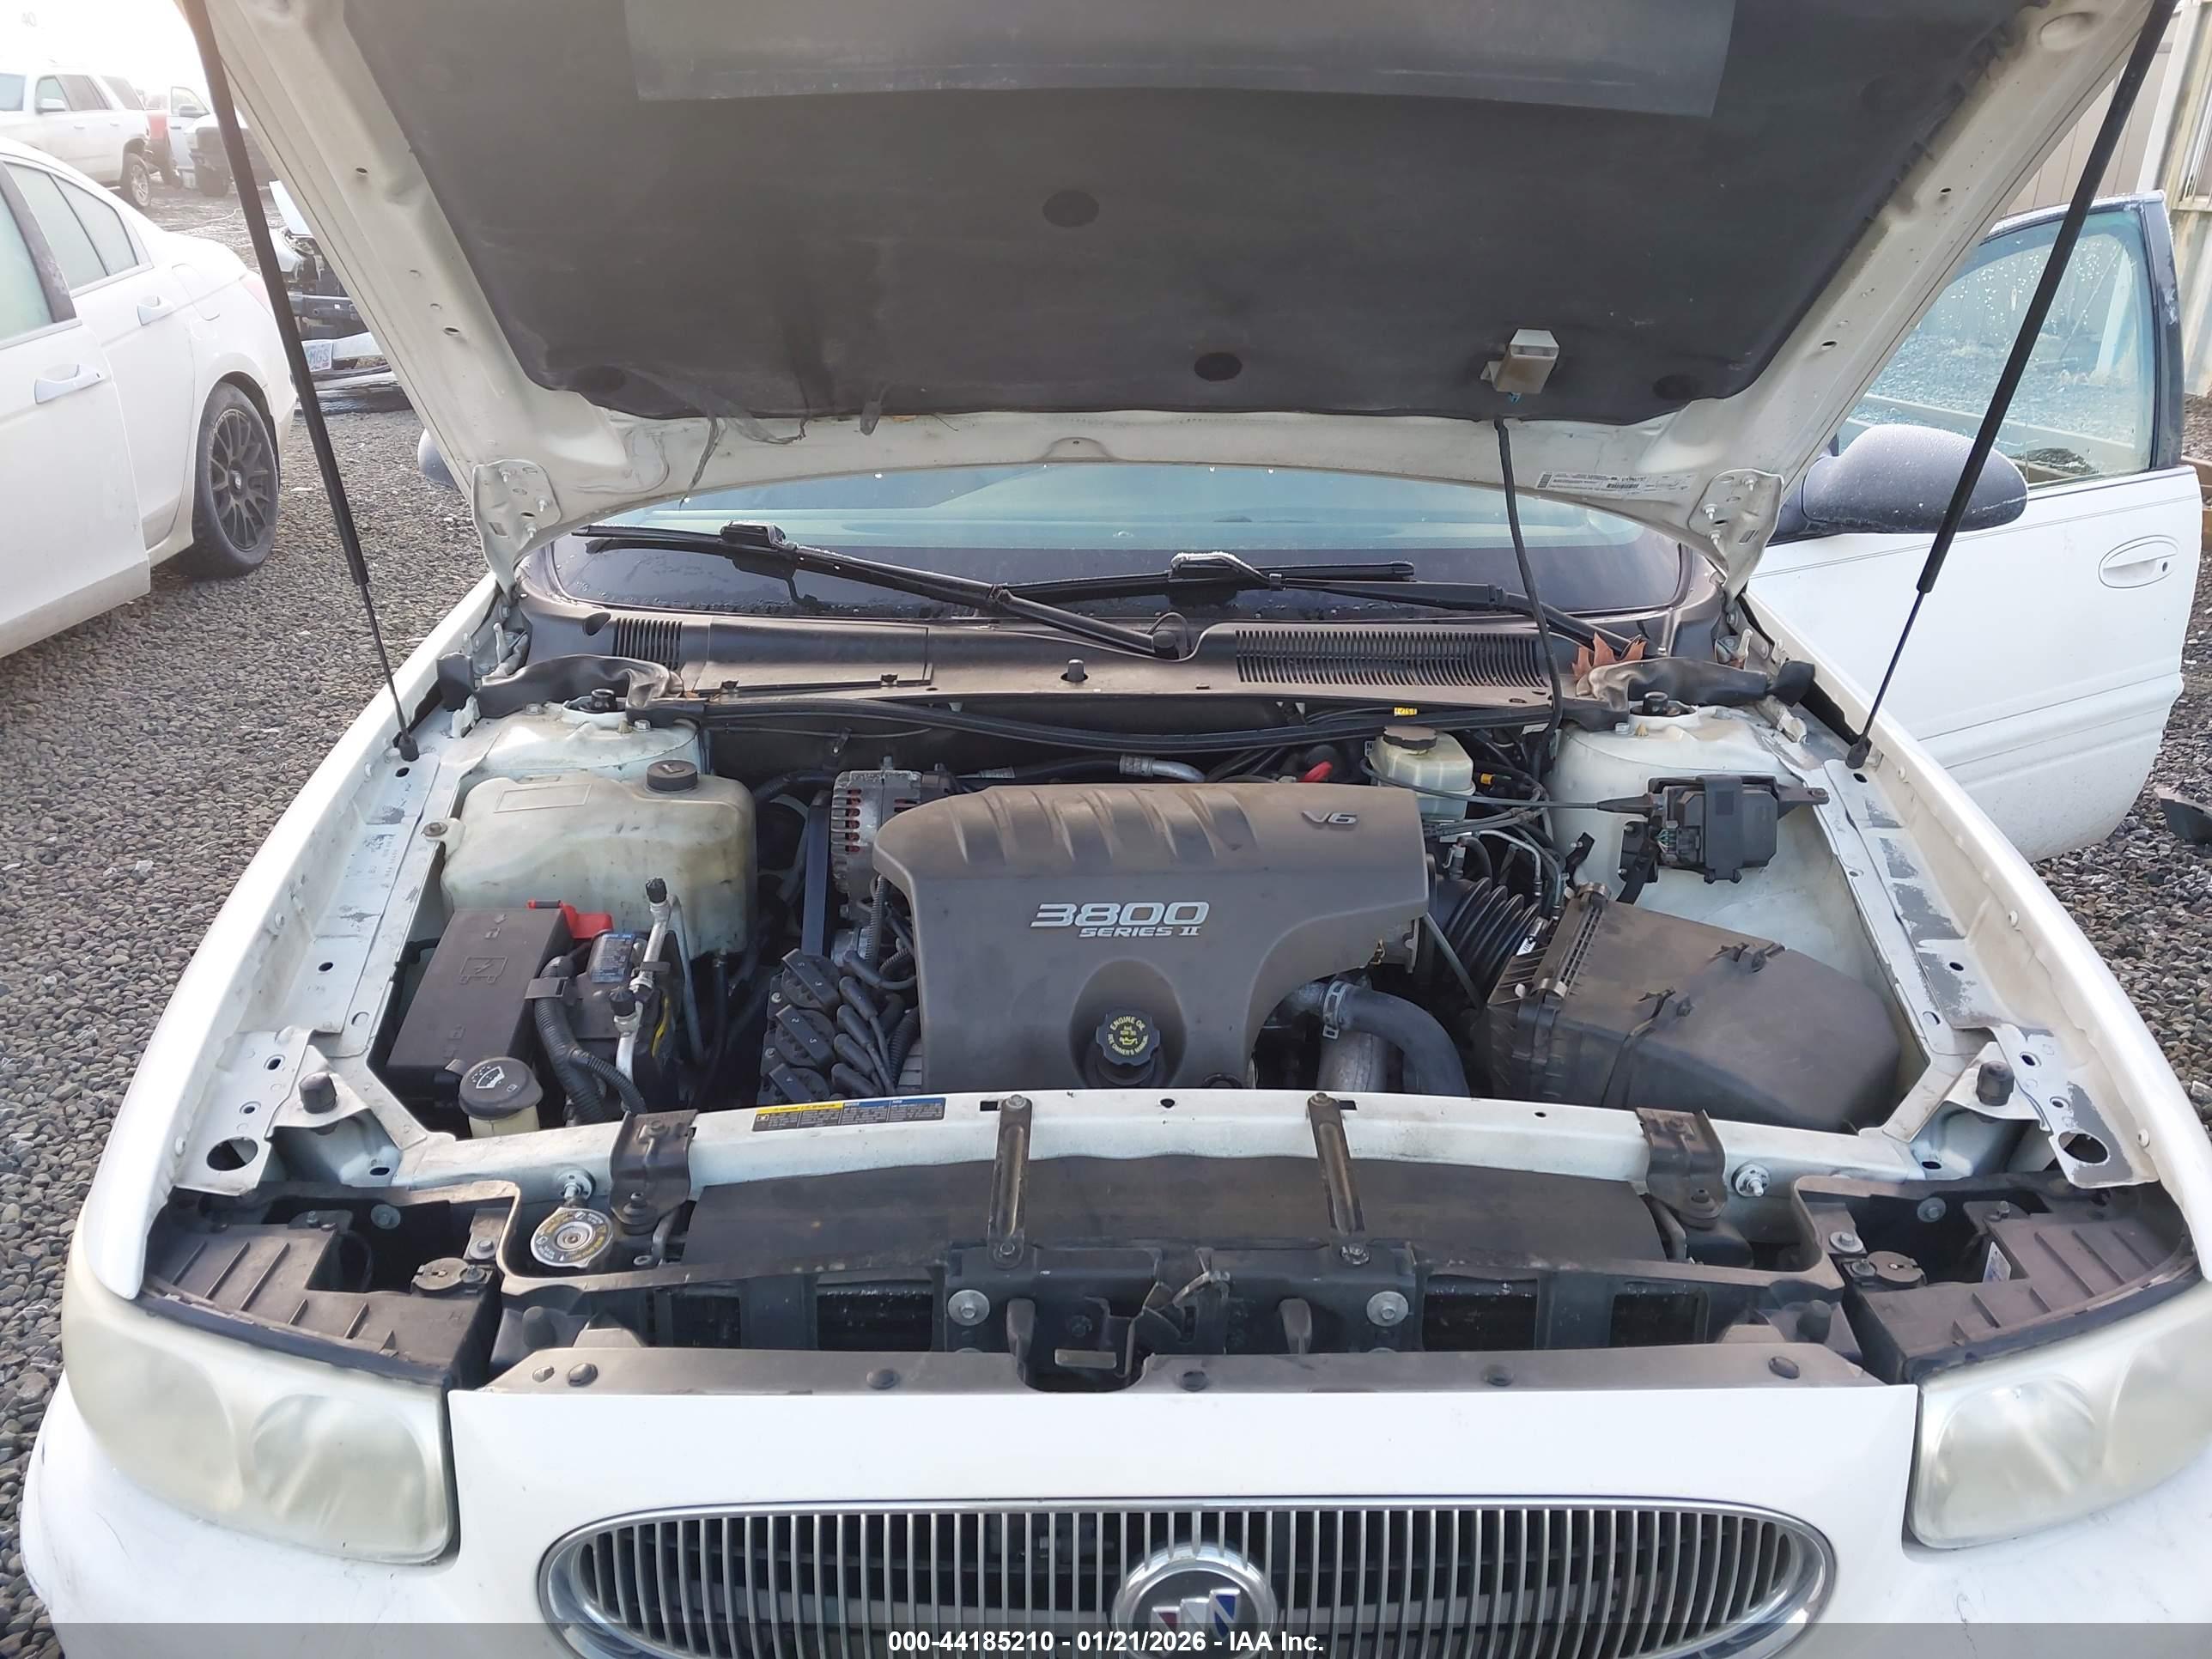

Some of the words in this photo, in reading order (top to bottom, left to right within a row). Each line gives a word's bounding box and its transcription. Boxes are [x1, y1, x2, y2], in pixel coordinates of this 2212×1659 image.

[1302, 810, 1358, 825] V6
[1030, 902, 1210, 927] 3800
[1079, 927, 1174, 938] SERIES
[1109, 1015, 1137, 1031] ENGINE
